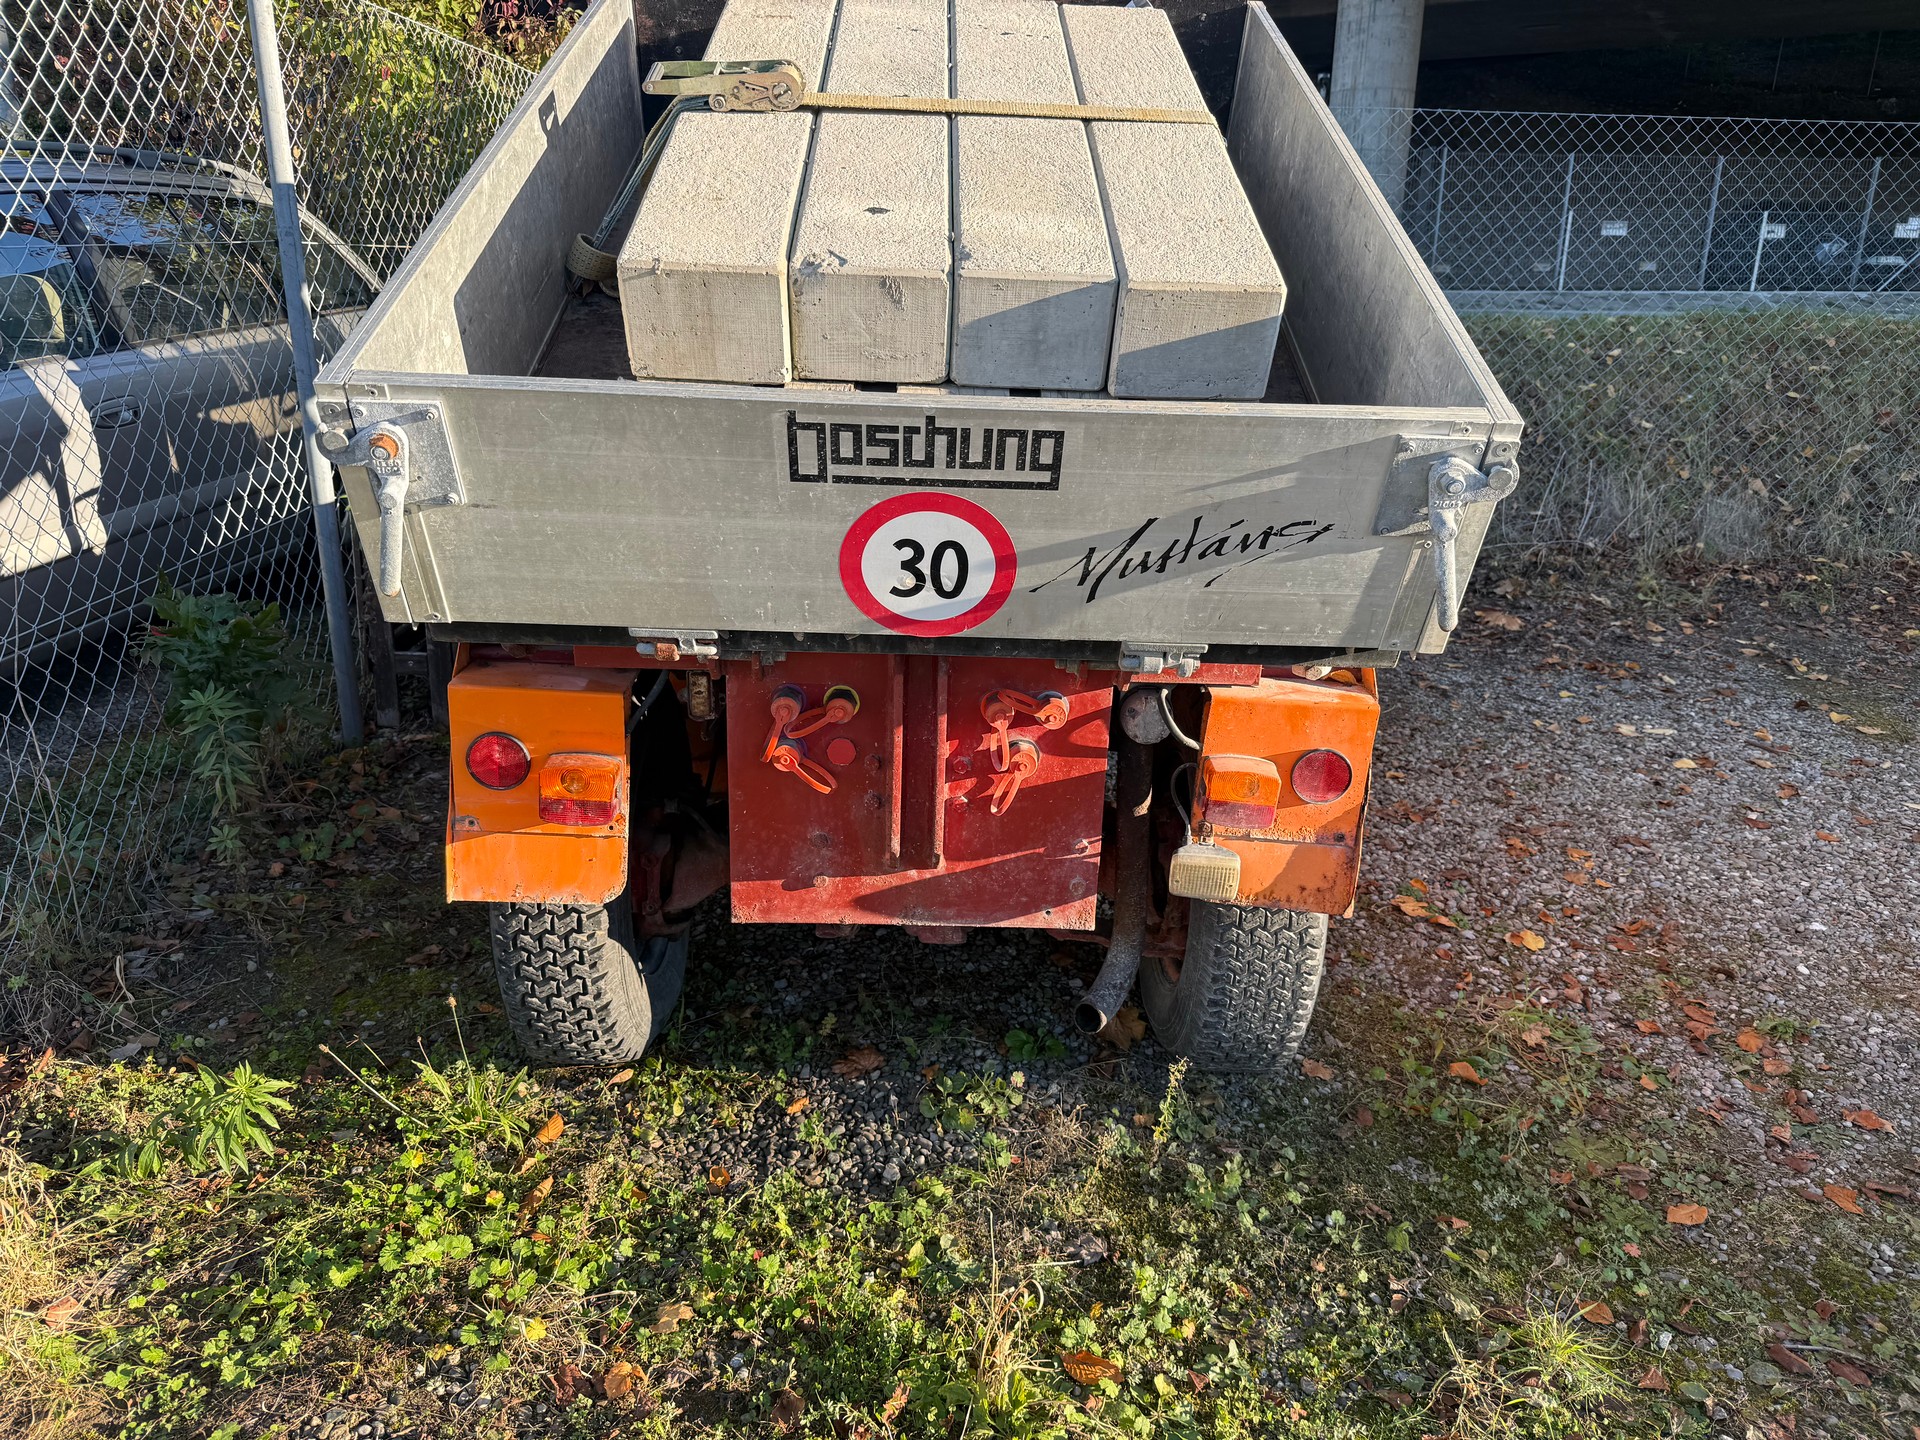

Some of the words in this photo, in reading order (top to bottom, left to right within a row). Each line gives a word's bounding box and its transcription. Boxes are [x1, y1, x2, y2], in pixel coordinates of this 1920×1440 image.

[787, 410, 1065, 491] boschung
[889, 538, 969, 600] 30
[1029, 515, 1335, 603] Mustang
